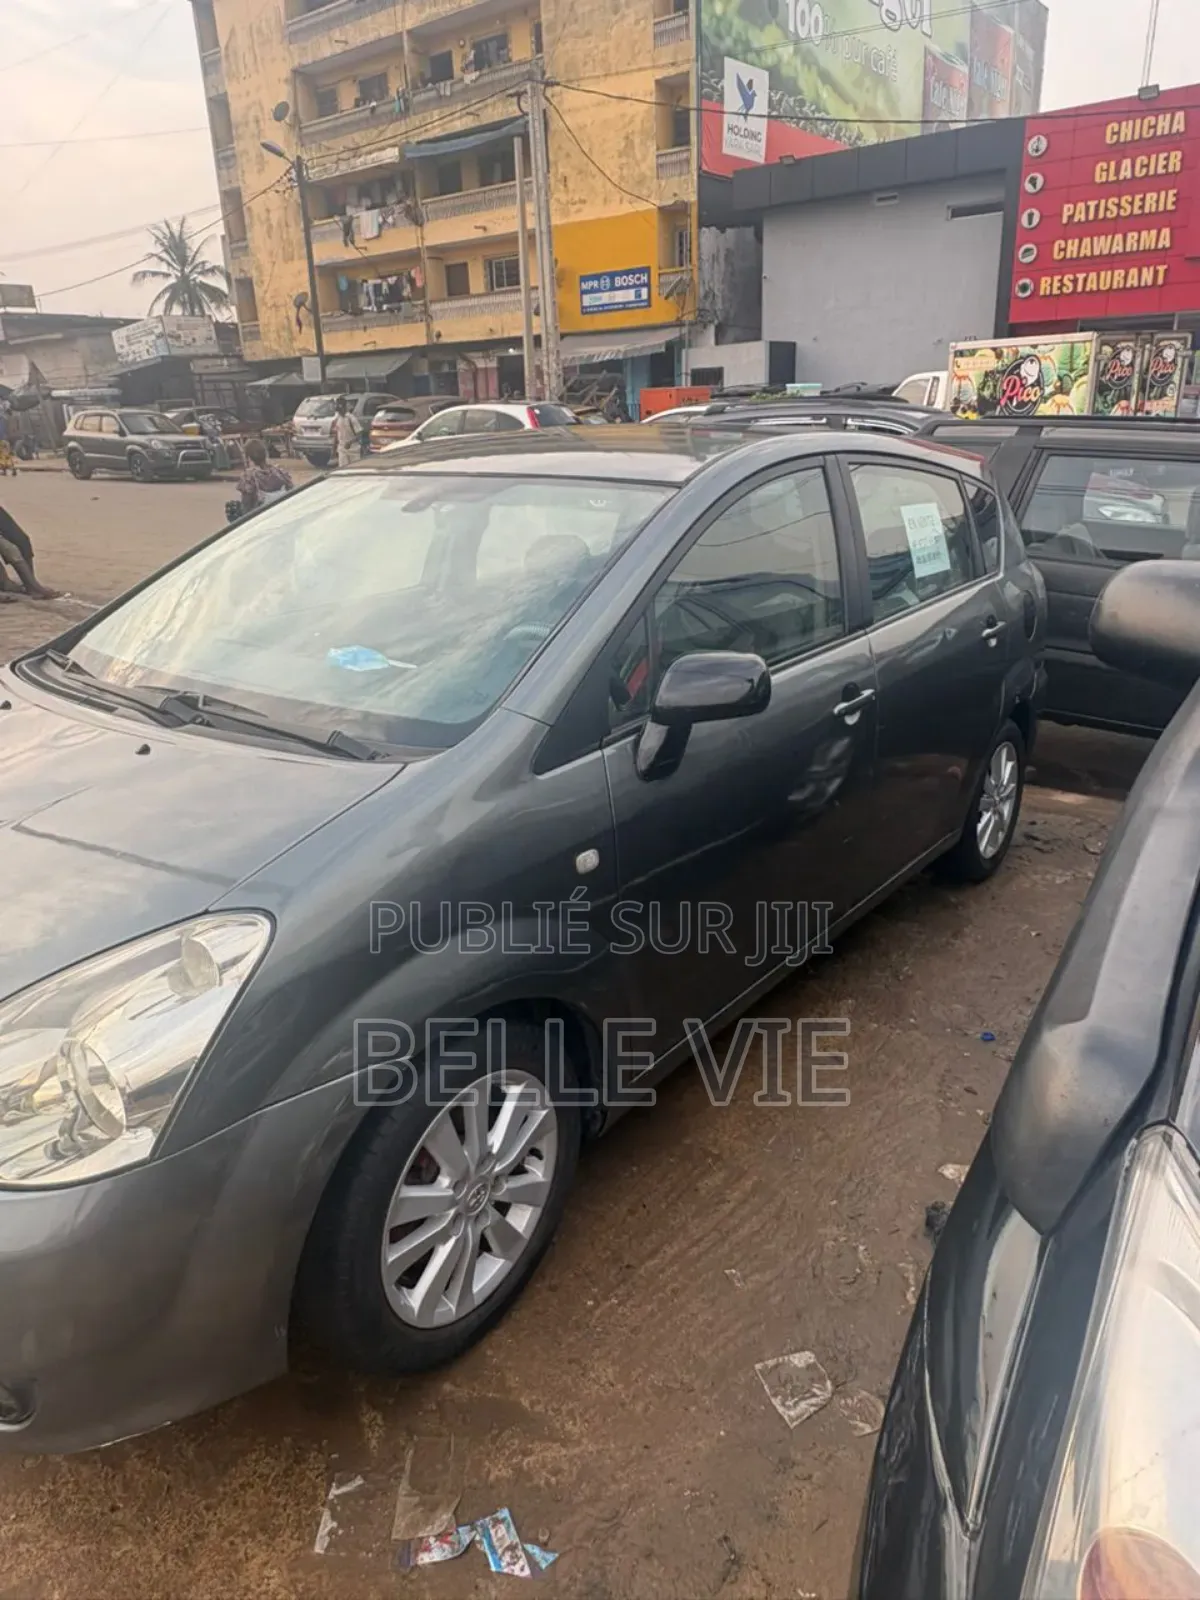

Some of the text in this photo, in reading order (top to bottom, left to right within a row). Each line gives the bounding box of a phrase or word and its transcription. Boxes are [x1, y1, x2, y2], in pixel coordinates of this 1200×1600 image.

[727, 124, 762, 143] HOLDING
[1105, 111, 1186, 145] CHICHA
[1094, 150, 1183, 184] GLACIER
[1061, 189, 1178, 225] PATISSERIE
[1053, 227, 1171, 261] CHAWARMA
[614, 272, 648, 287] BOSCH
[1039, 264, 1168, 296] RESTAURANT
[999, 375, 1041, 406] Pico
